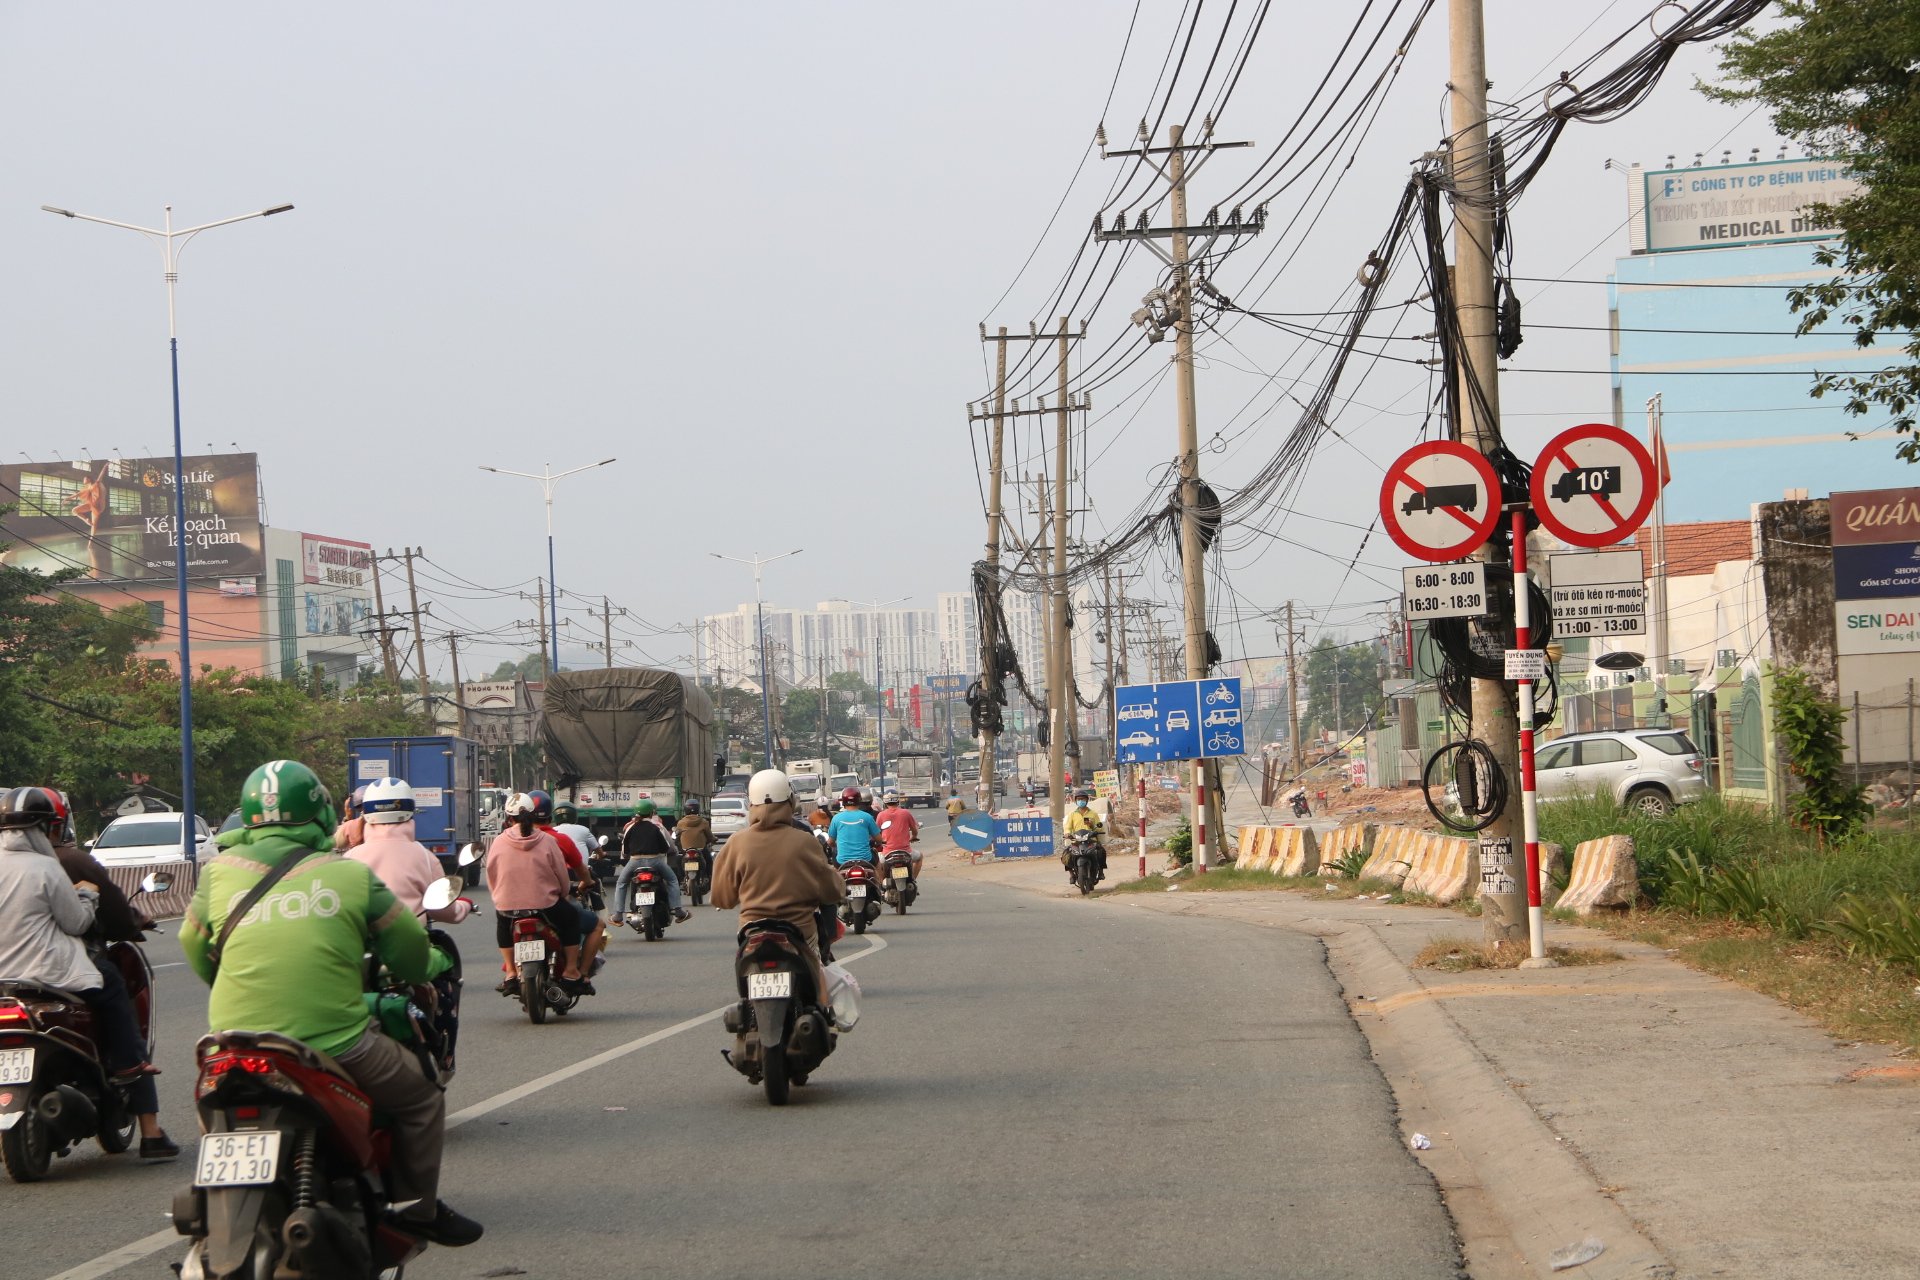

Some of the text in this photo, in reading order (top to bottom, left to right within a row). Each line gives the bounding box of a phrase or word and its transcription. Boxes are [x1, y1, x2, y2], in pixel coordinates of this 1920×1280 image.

[1692, 177, 1726, 192] CÔNG
[1730, 177, 1744, 189] TY
[1748, 175, 1765, 187] CP
[1769, 171, 1803, 187] BỆNH
[1807, 167, 1836, 183] VIỆN
[1700, 219, 1784, 240] MEDICAL
[190, 470, 215, 483] Life
[145, 514, 169, 534] Kế
[196, 531, 242, 550] quan
[1415, 573, 1439, 588] 6:00
[1450, 571, 1474, 585] 8:00
[1860, 578, 1880, 587] GỐM
[1409, 597, 1438, 612] 16:30
[1450, 594, 1481, 608] 18:30
[1571, 589, 1585, 601] ôtô
[1587, 589, 1603, 600] kéo
[1565, 607, 1576, 616] xe
[1557, 621, 1591, 634] 11:00
[1603, 618, 1638, 631] 13:00
[1847, 612, 1914, 629] SEN DAI
[1880, 632, 1904, 641] Lotus
[756, 973, 784, 985] 49-M1
[753, 985, 788, 997] 139.72
[213, 1135, 267, 1158] 36-E1
[203, 1159, 271, 1183] 321.30
